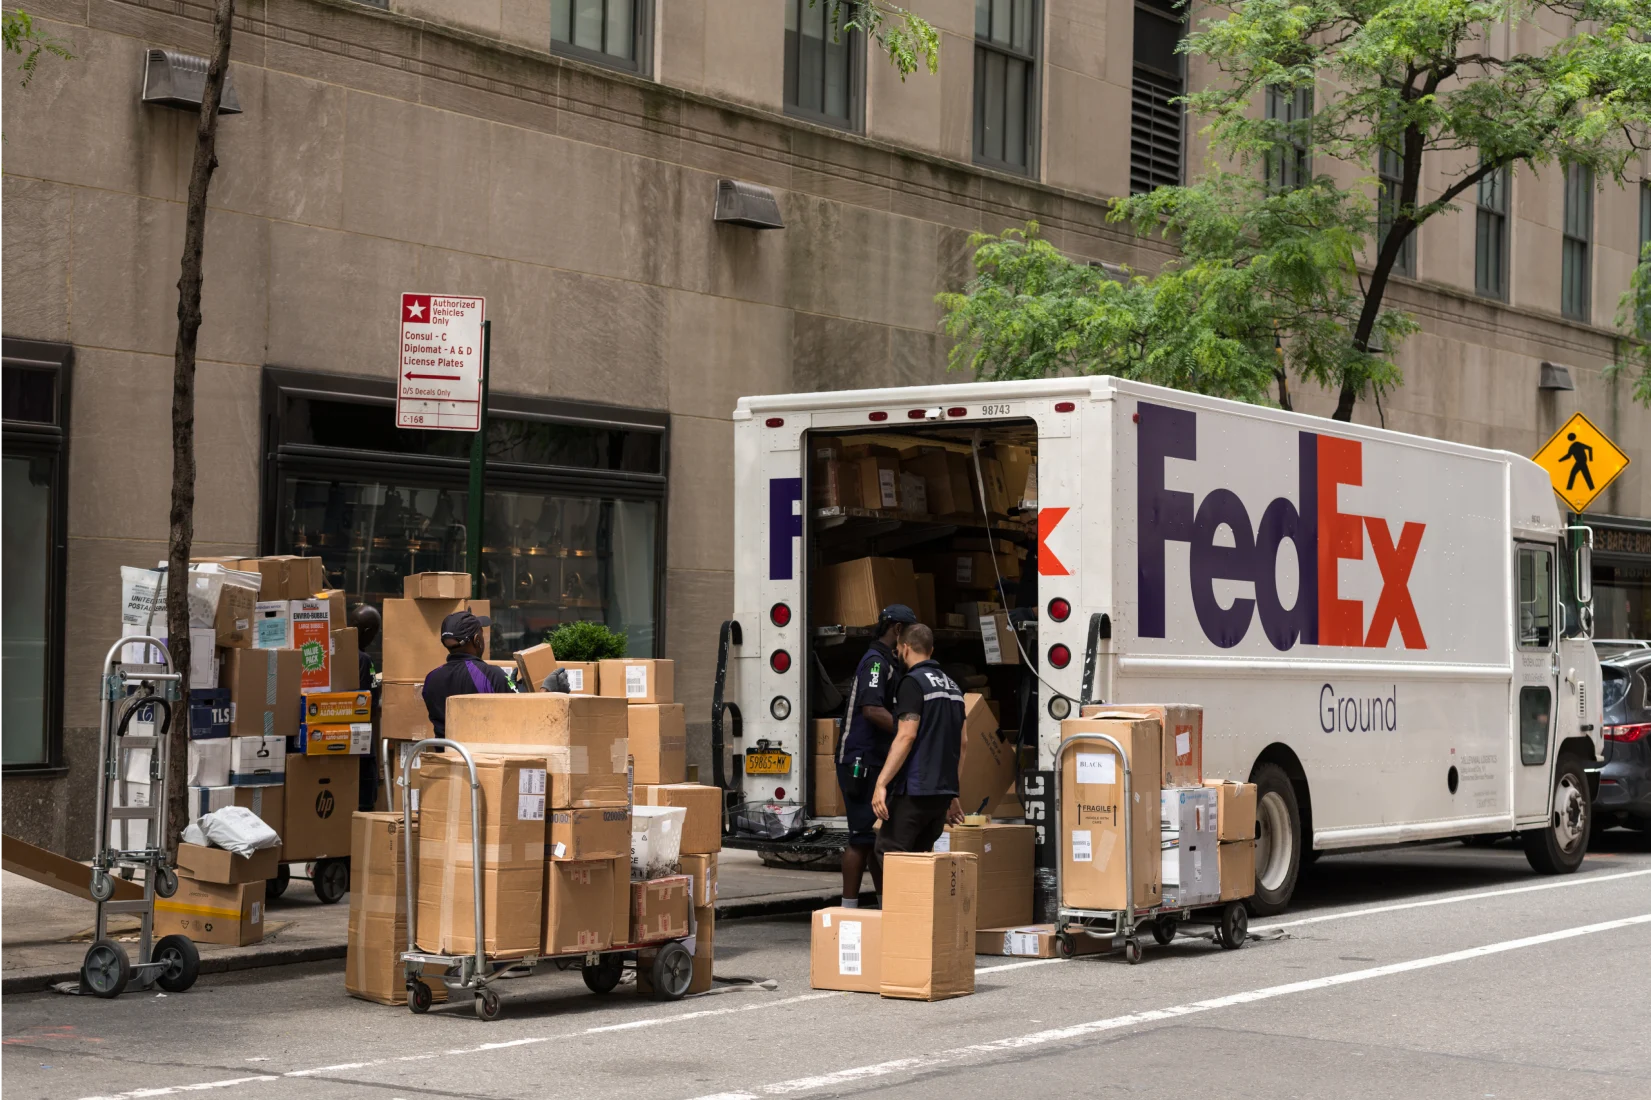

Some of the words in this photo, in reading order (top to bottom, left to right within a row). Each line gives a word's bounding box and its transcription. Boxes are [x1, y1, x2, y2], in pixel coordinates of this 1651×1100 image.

[433, 299, 476, 309] Authorized
[433, 308, 464, 317] Vehicles
[432, 317, 449, 326] Only
[405, 331, 433, 340] Consul
[441, 333, 447, 341] C
[404, 344, 442, 354] Diplomat
[450, 346, 455, 354] A
[458, 347, 463, 355] &
[467, 347, 472, 355] D
[404, 357, 435, 366] License
[438, 358, 464, 368] Plates
[415, 388, 435, 396] Decals
[437, 388, 451, 398] Only
[982, 404, 1010, 416] 98743
[403, 415, 424, 424] C-168
[1137, 400, 1428, 652] FedEx
[293, 612, 328, 620] ENVIRO-BUBBLE
[304, 646, 319, 657] VALUE
[306, 655, 318, 664] PACK
[869, 662, 880, 688] FedEx
[1319, 683, 1396, 733] Ground
[212, 708, 230, 723] TLS
[317, 790, 333, 819] hp
